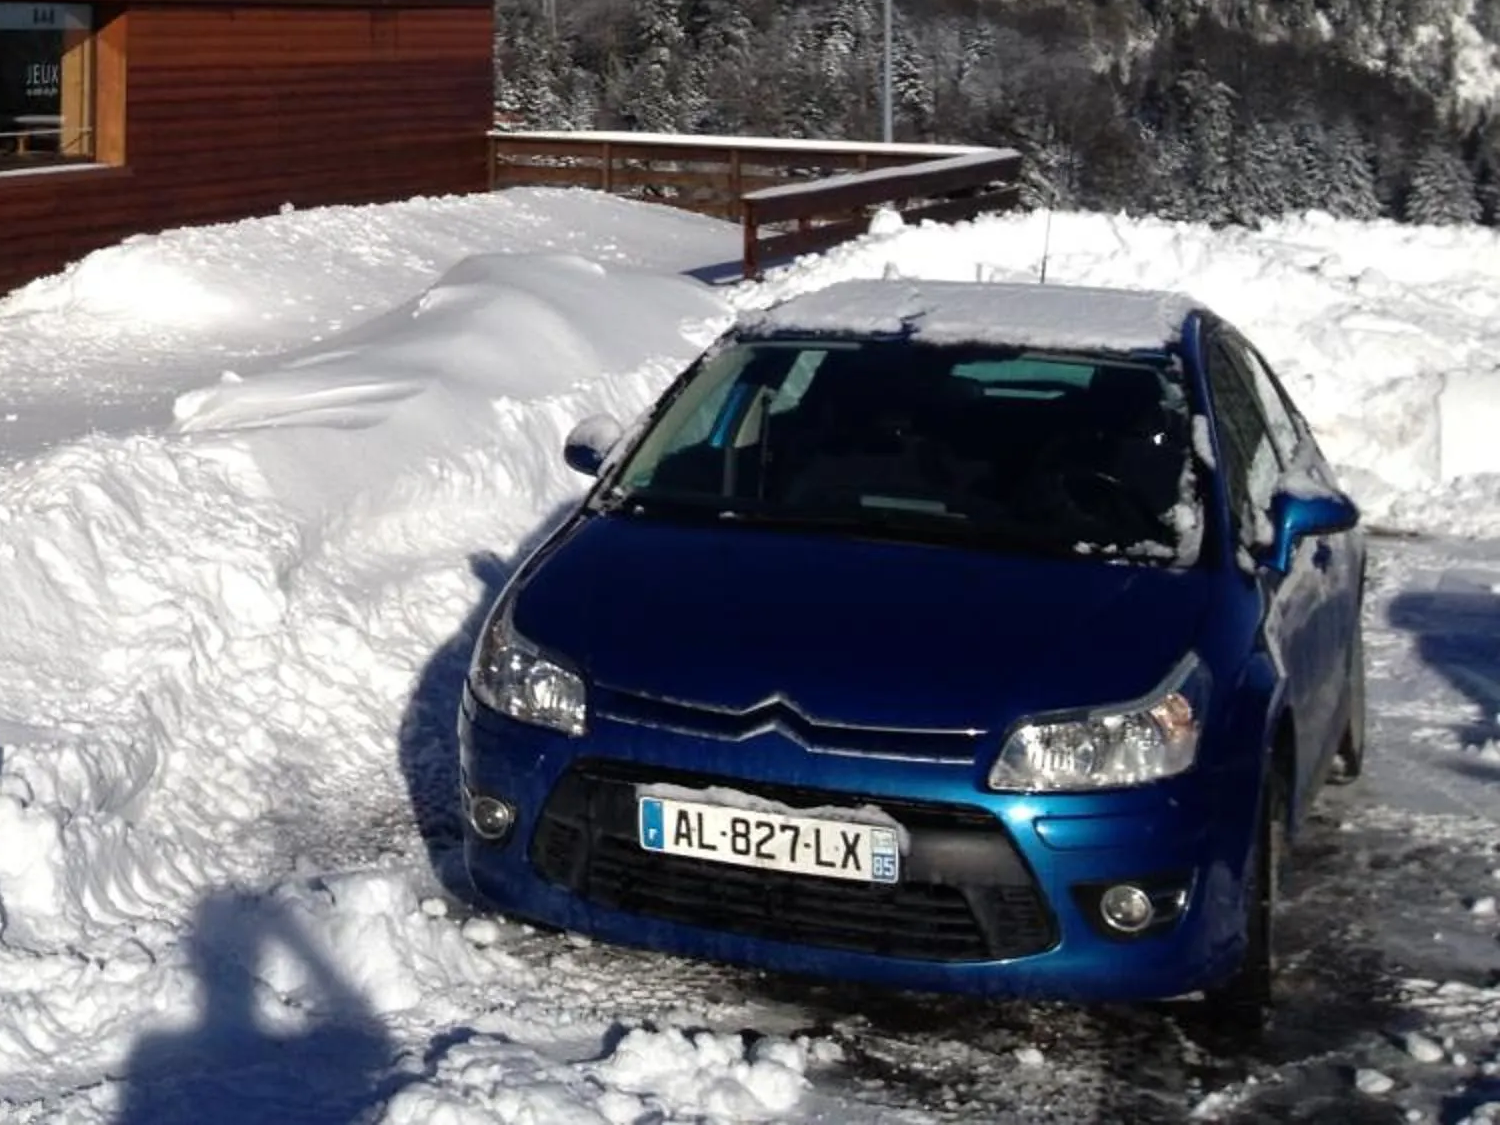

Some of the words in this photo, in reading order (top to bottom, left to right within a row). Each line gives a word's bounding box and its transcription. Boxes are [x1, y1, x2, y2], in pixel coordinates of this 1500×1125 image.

[25, 63, 59, 85] JEUX
[673, 809, 862, 871] AL-827-LX
[873, 854, 895, 876] 85
